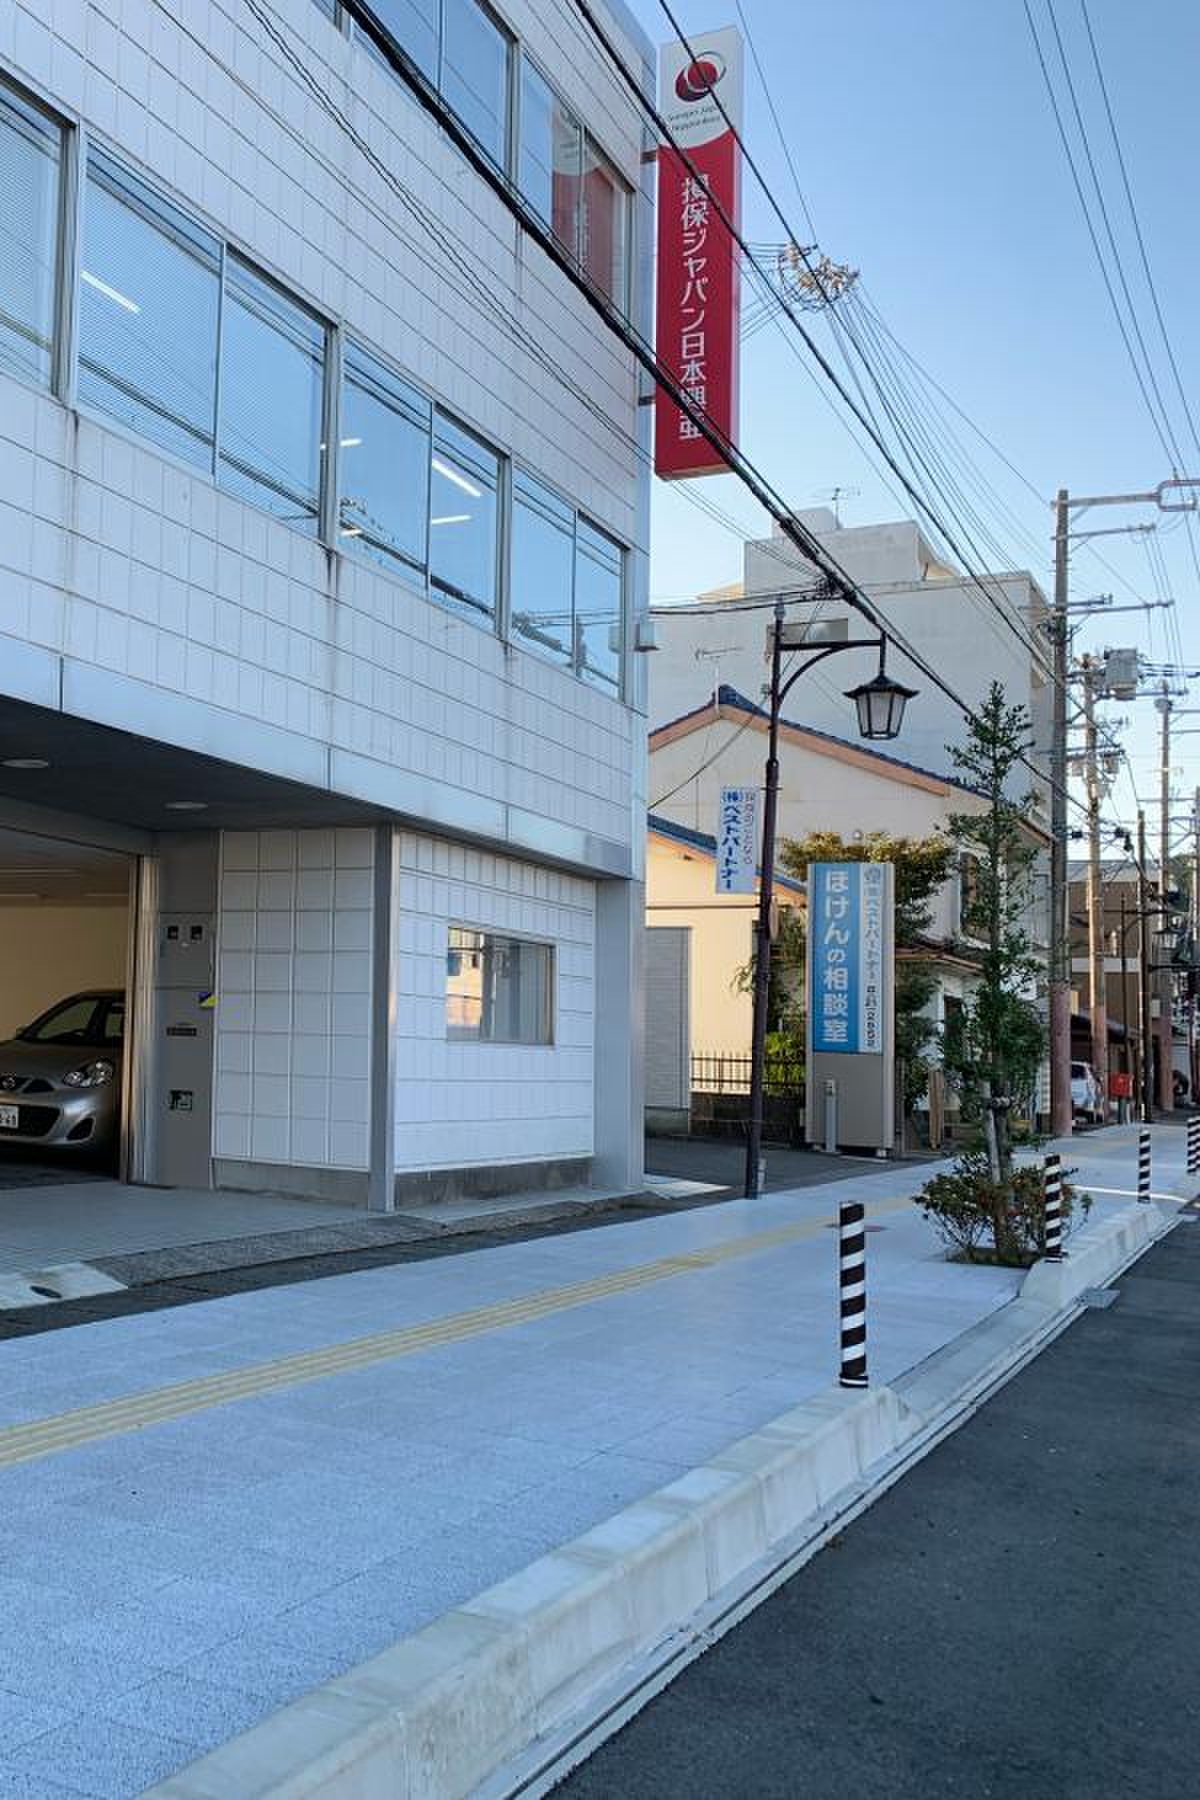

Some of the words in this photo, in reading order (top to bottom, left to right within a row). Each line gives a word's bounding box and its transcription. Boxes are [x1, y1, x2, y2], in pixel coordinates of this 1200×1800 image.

[823, 870, 850, 1043] ほけんの相談室
